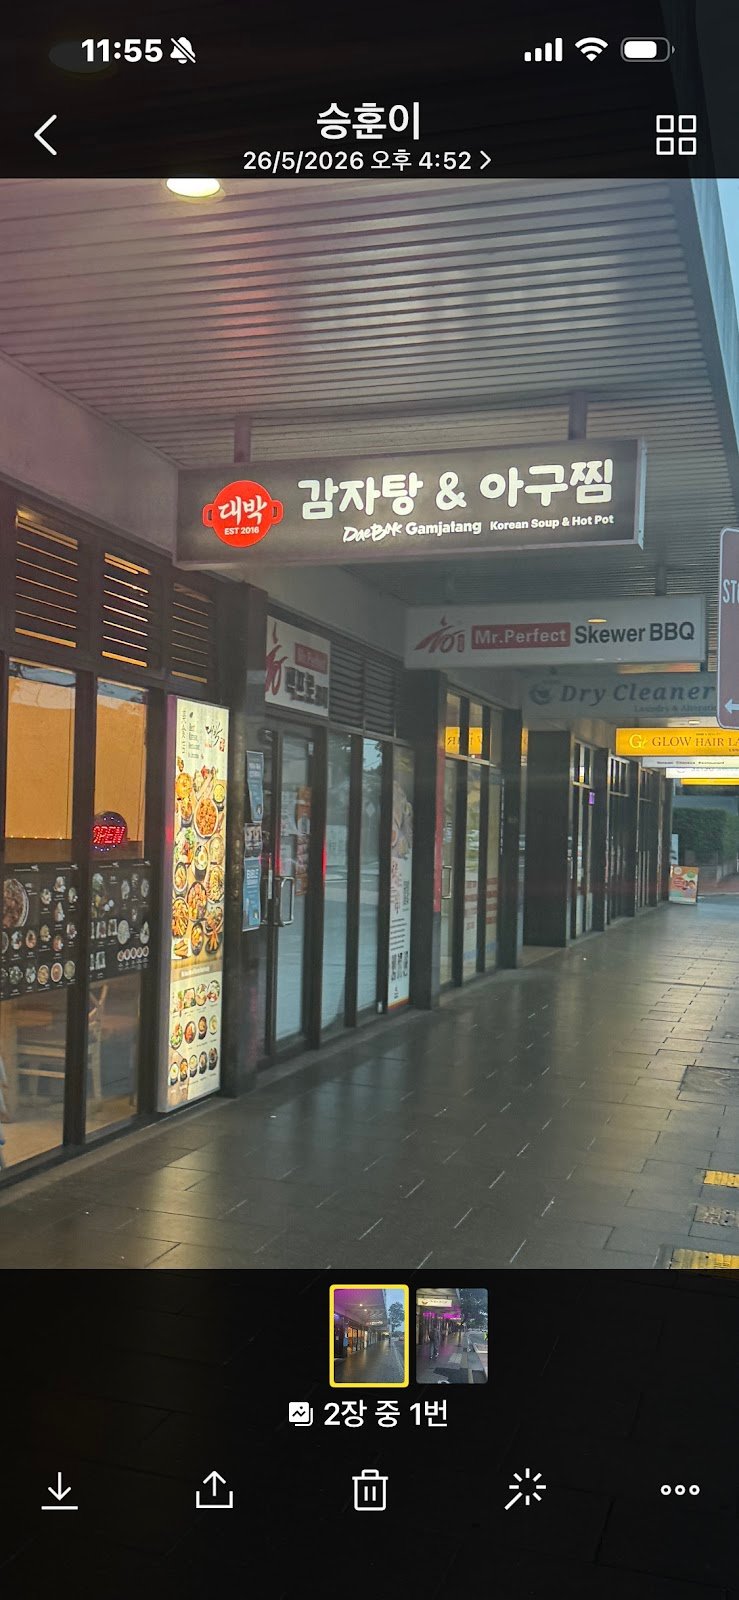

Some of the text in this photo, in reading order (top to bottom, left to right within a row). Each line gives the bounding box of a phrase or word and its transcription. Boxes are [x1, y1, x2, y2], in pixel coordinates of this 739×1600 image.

[297, 458, 614, 520] 감자탕 & 아구찜
[217, 494, 268, 525] 대박
[224, 526, 260, 536] EST 2016
[490, 521, 529, 531] Korean
[531, 519, 560, 530] Soup
[562, 517, 570, 527] &
[572, 516, 593, 526] Hot
[595, 514, 614, 525] Pot
[722, 578, 739, 604] ST
[475, 628, 567, 644] Mr.Perfect
[574, 624, 646, 644] Skewer
[649, 621, 695, 641] BBQ
[560, 685, 606, 707] Dry
[651, 736, 692, 747] GLOW
[695, 737, 724, 747] HAIR
[93, 826, 125, 844] OPEN
